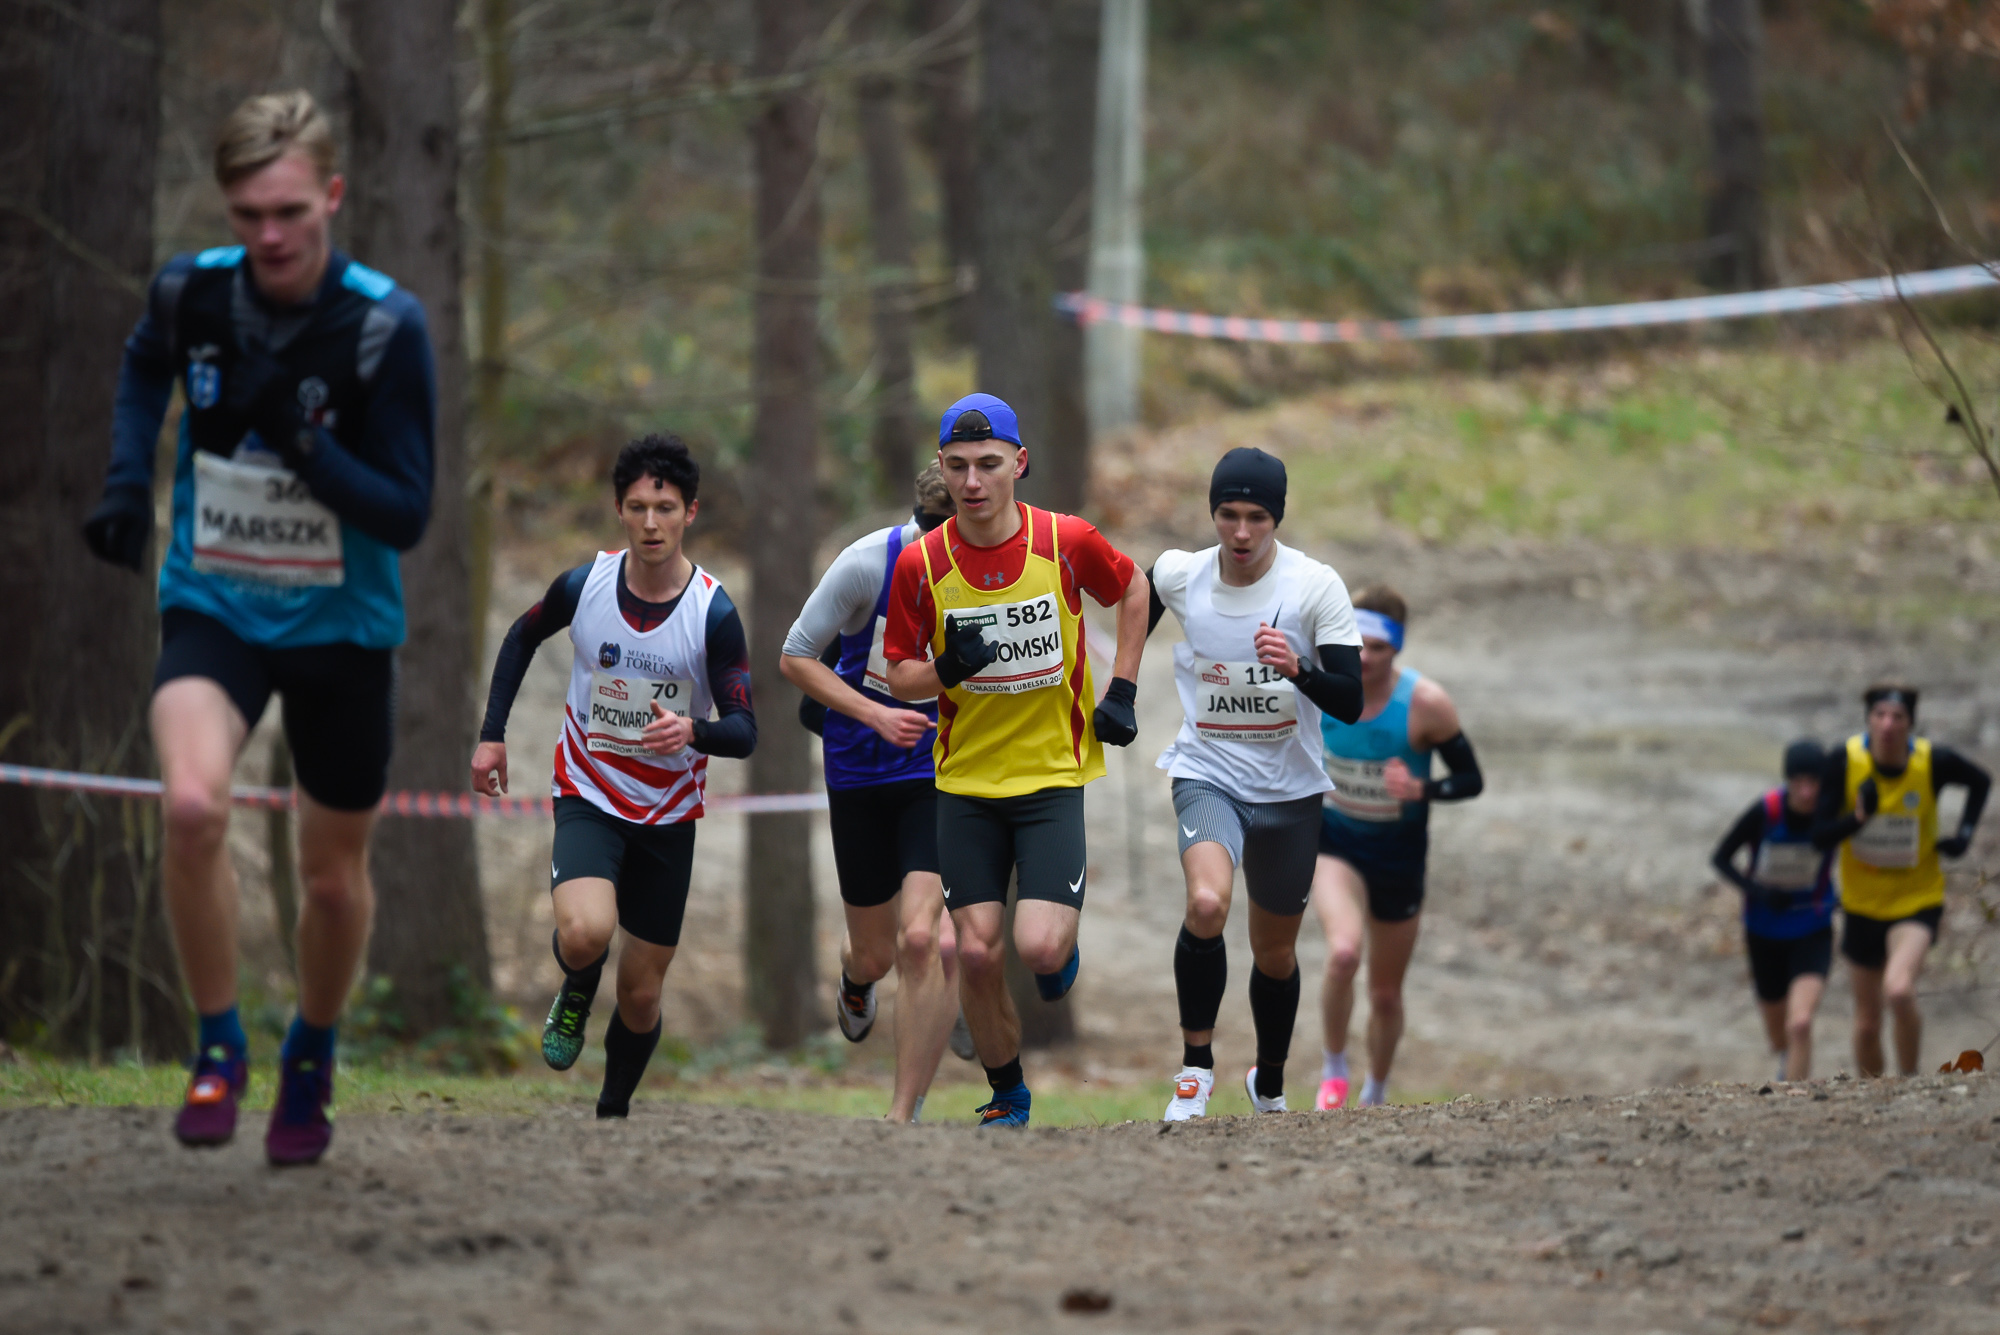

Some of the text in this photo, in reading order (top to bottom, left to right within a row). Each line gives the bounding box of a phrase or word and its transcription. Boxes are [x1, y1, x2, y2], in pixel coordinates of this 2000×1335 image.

[1006, 600, 1053, 627] 582
[989, 631, 1059, 663] OMSKI
[627, 649, 664, 662] MIASTO
[624, 656, 675, 676] TORUŃ
[965, 682, 1011, 692] TOMASZÓW
[1012, 678, 1048, 692] LUBELSKI
[1203, 675, 1228, 685] ORLEN
[600, 687, 627, 700] ORLEN
[651, 683, 678, 699] 70
[1207, 694, 1279, 714] JANIEC
[1200, 730, 1242, 740] TOMASZÓW
[1244, 731, 1276, 740] LUBELSKI
[591, 741, 633, 753] TOMASZÓW
